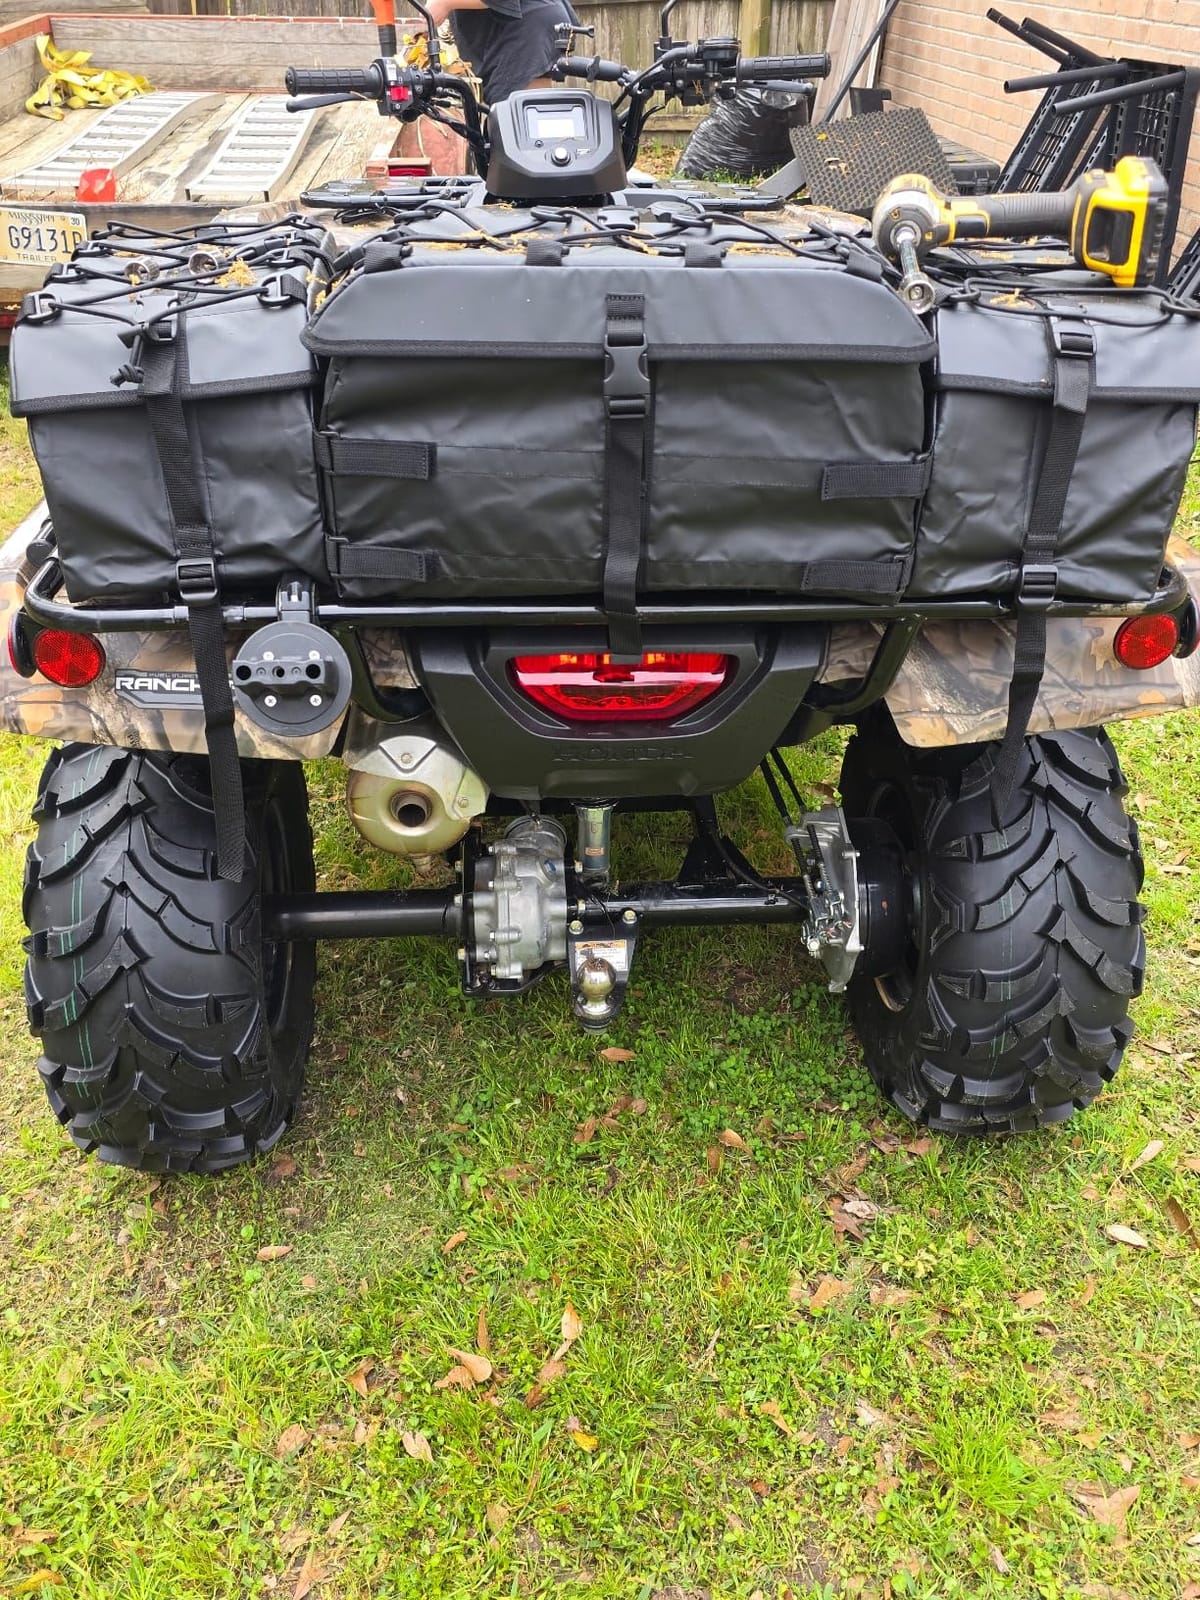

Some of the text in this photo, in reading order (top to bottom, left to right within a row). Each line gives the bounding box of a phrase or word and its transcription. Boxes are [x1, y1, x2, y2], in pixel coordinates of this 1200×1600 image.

[8, 211, 55, 225] MISSISSIPPI
[16, 252, 57, 262] TRAILER
[115, 677, 235, 692] RANCH
